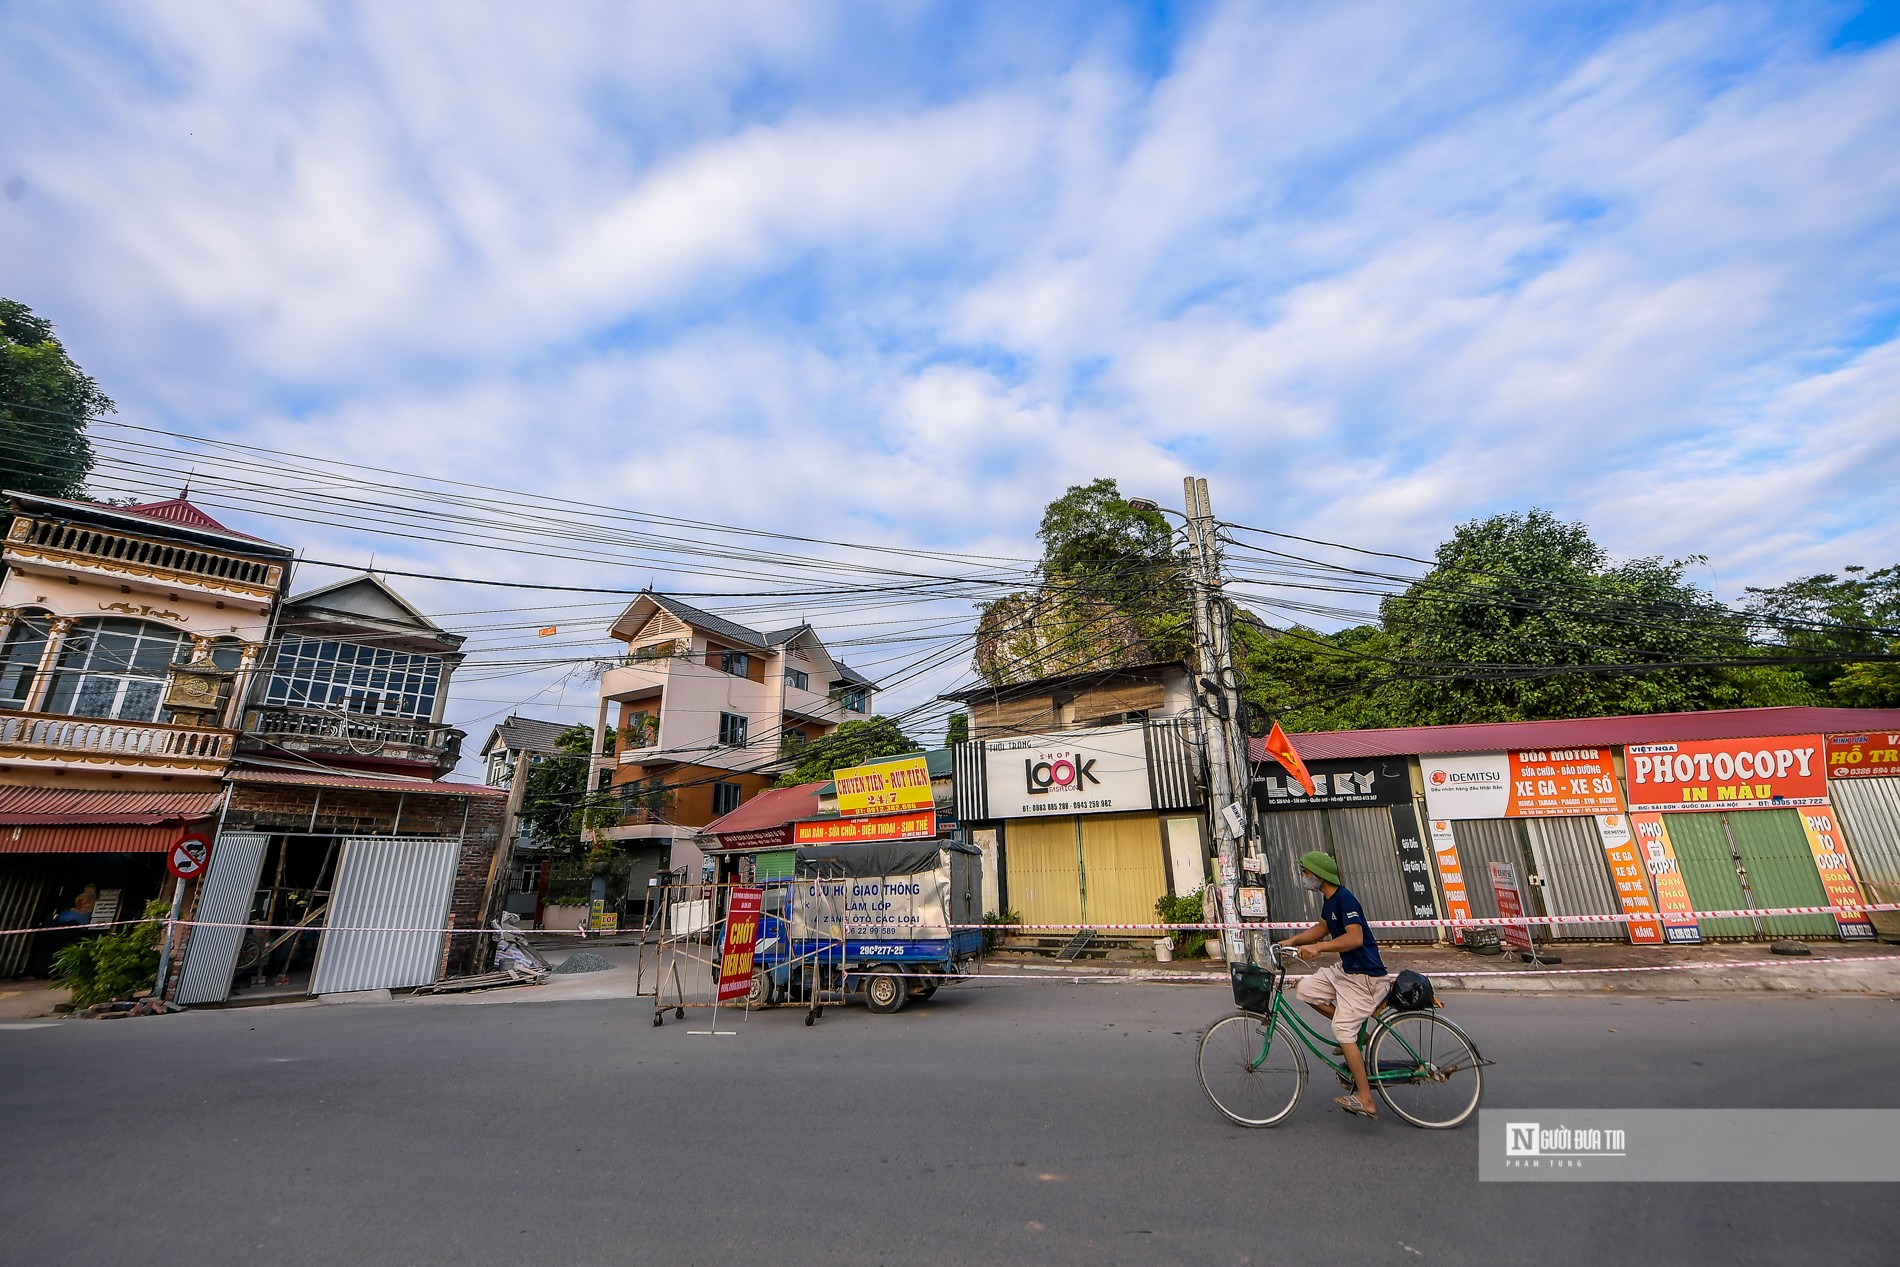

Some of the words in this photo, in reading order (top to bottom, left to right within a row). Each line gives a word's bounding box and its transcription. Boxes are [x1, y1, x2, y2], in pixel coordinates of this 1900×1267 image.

[1887, 734, 1900, 746] V
[1631, 745, 1653, 753] VIỆT
[1656, 744, 1675, 752] NGA
[1830, 744, 1863, 765] HỖ
[1869, 749, 1900, 763] TR
[1040, 752, 1070, 760] SHOP
[1551, 749, 1599, 762] MOTOR
[1521, 765, 1536, 777] SỬA
[1536, 764, 1557, 777] CHỮA
[1561, 764, 1576, 776] BẢO
[1576, 763, 1602, 775] DƯỠNG
[1633, 747, 1815, 784] PHOTOCOPY
[1449, 771, 1501, 783] IDEMITSU
[1049, 784, 1079, 793] FASHION
[1267, 771, 1375, 797] LUCKY
[1515, 781, 1534, 797] XE
[1537, 780, 1558, 796] GA
[1571, 779, 1591, 795] XE
[1593, 772, 1614, 794] SỐ
[867, 792, 897, 805] 24/7
[1682, 787, 1708, 802] IN
[1717, 782, 1772, 801] MÀU
[799, 828, 812, 839] MUA
[812, 826, 825, 838] BÁN
[828, 824, 840, 837] SỬA
[840, 824, 857, 837] CHỮA
[861, 822, 876, 838] ĐIỆN
[877, 822, 897, 836] THOẠI
[901, 821, 915, 832] SIM
[915, 815, 928, 830] THẺ
[1638, 823, 1663, 838] PHO
[1807, 816, 1831, 832] PHO
[1817, 835, 1834, 850] TO
[1440, 855, 1456, 866] HONDA
[1611, 852, 1621, 861] XE
[1622, 852, 1633, 861] GA
[1818, 854, 1847, 870] COPY
[1615, 867, 1625, 877] XE
[1627, 863, 1637, 876] SỐ
[1647, 858, 1678, 875] COPY
[1442, 873, 1462, 884] YAMAHA
[1656, 878, 1680, 888] SOẠN
[1825, 873, 1851, 883] SOẠN
[853, 884, 879, 897] GIAO
[884, 882, 920, 896] THÔNG
[1618, 882, 1632, 892] THAY
[1660, 887, 1684, 898] THẢO
[1829, 881, 1855, 894] THẢO
[1446, 891, 1465, 902] PIAGGIO
[1622, 897, 1634, 909] PHỤ
[1634, 895, 1649, 907] TÙNG
[845, 900, 867, 911] LÀM
[1666, 902, 1686, 910] VĂN
[875, 914, 895, 923] CÁC
[729, 916, 755, 945] CHỐT
[881, 927, 896, 935] 589
[722, 946, 740, 977] KIỂM
